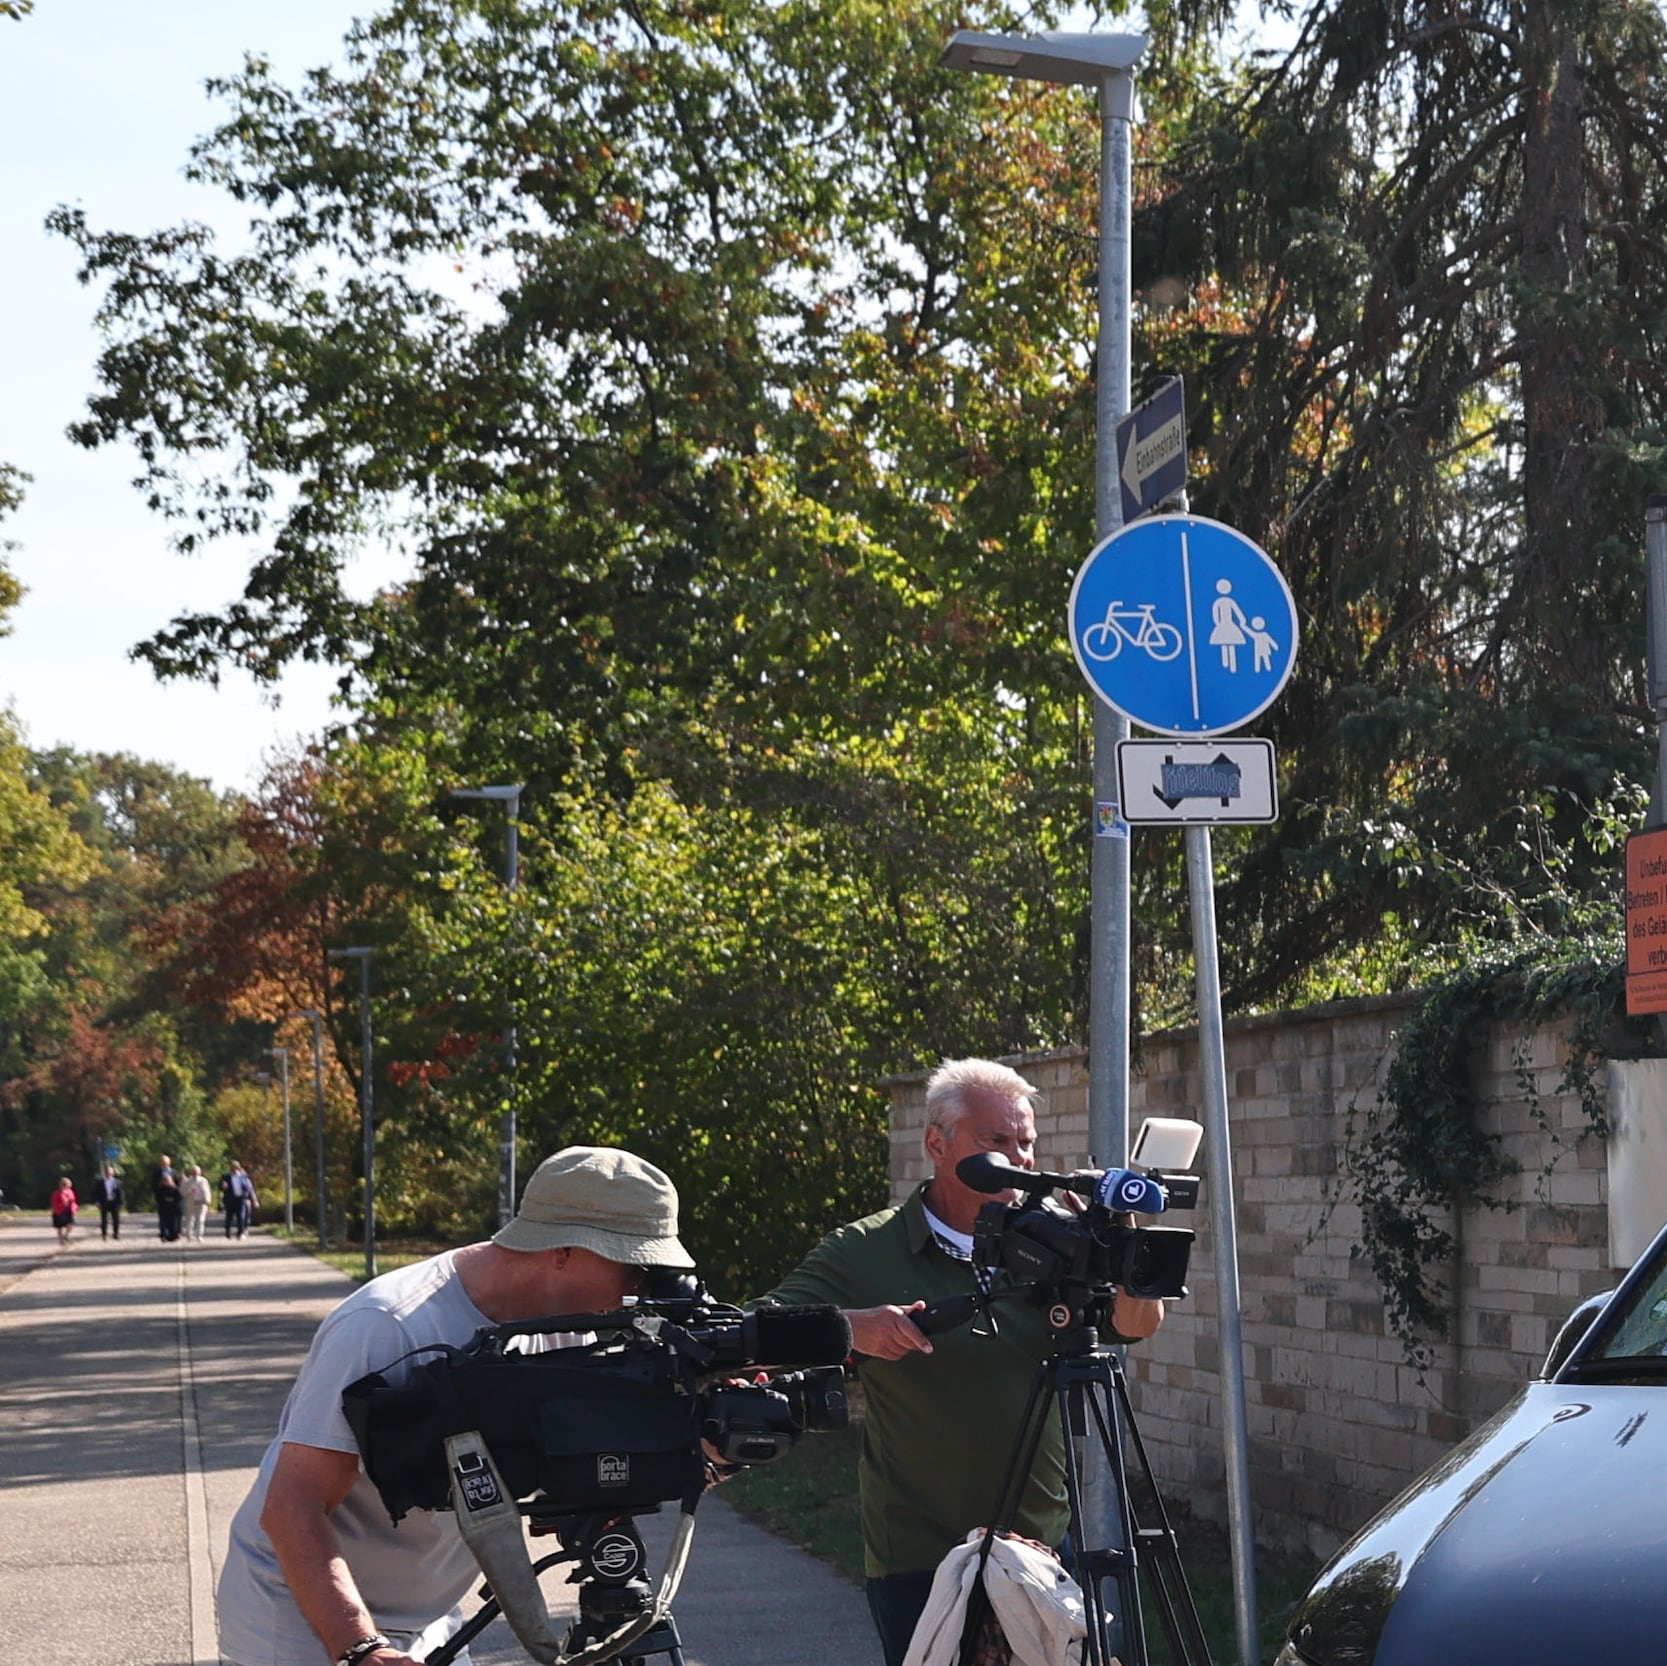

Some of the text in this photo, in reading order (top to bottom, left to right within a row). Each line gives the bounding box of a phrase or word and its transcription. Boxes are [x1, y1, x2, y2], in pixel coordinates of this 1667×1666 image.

[1136, 424, 1181, 475] Einbahnstraße
[1627, 890, 1659, 910] Betreten
[1632, 919, 1646, 938] des
[1017, 1249, 1043, 1265] SONY
